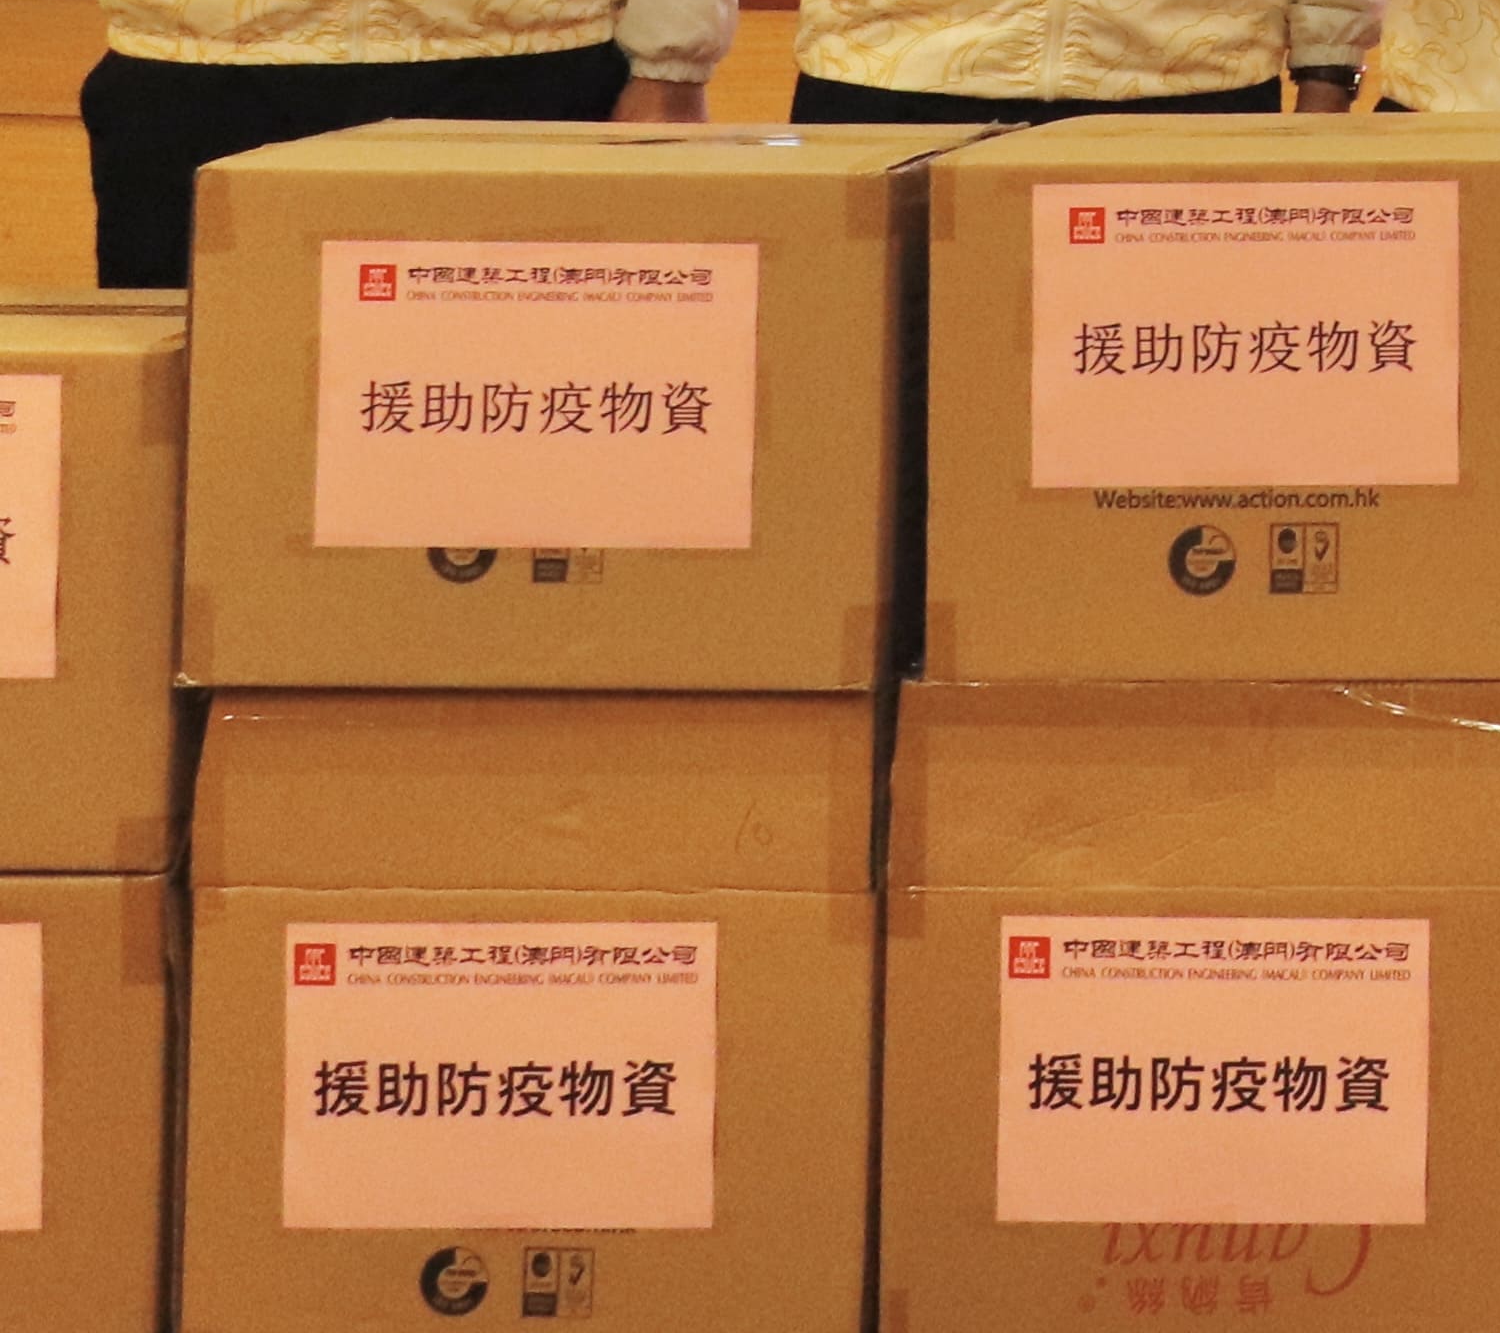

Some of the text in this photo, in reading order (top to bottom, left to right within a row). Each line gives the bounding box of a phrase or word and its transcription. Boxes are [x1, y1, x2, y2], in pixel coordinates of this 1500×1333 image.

[1073, 319, 1416, 376] 援助防疫物資
[360, 380, 712, 435] 援助防疫物資
[1094, 488, 1381, 510] Website:www.action.com.hk
[313, 1059, 677, 1118] 援助防疫物資
[1027, 1052, 1390, 1113] 援助防疫物資
